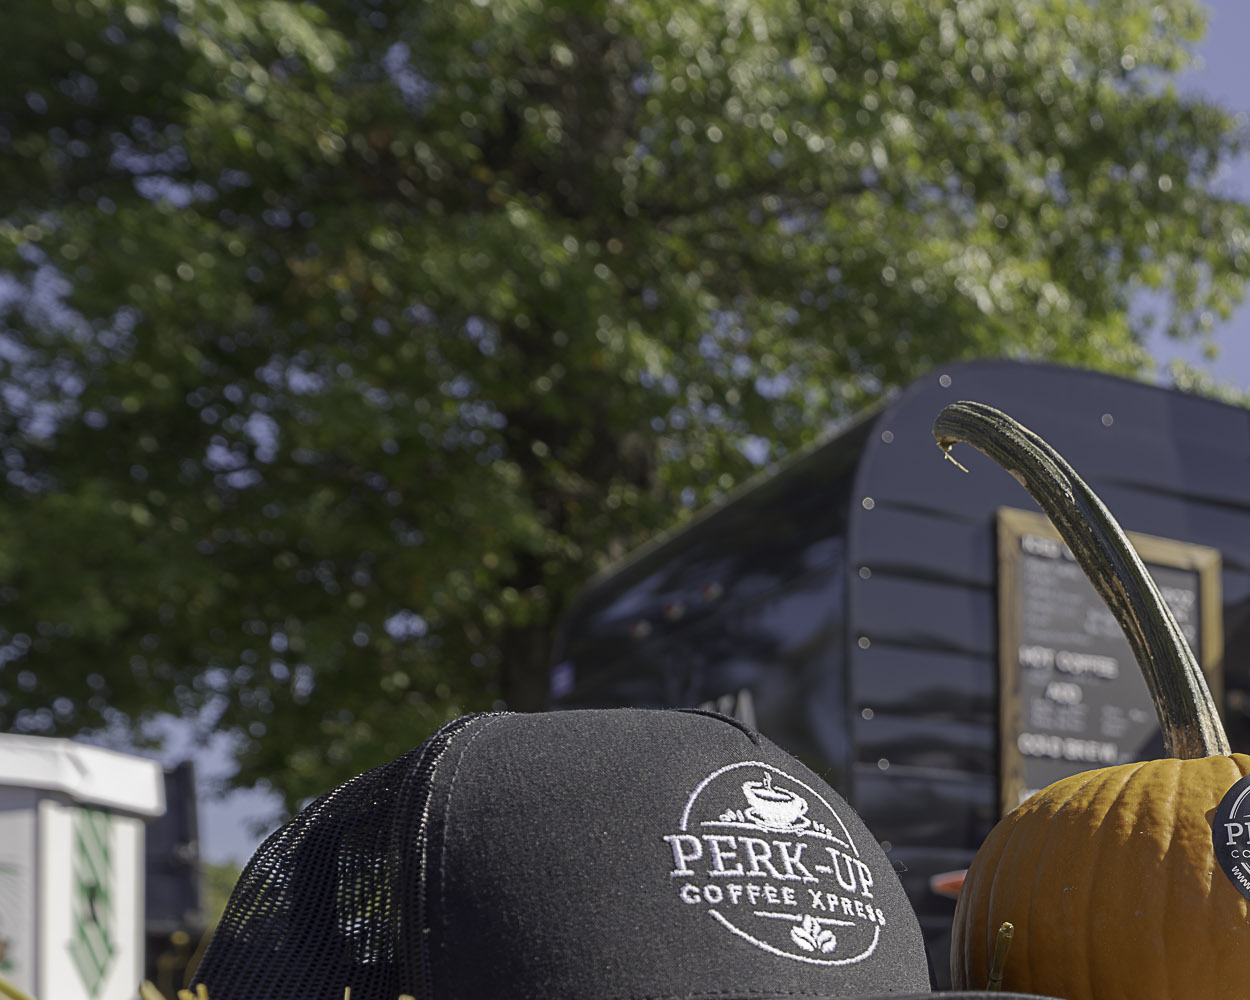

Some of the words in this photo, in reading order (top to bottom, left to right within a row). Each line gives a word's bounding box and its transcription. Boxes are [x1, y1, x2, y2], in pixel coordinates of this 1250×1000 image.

[663, 834, 874, 898] PERK-UP
[680, 882, 797, 906] COFFEE
[808, 888, 886, 926] XPRESS
